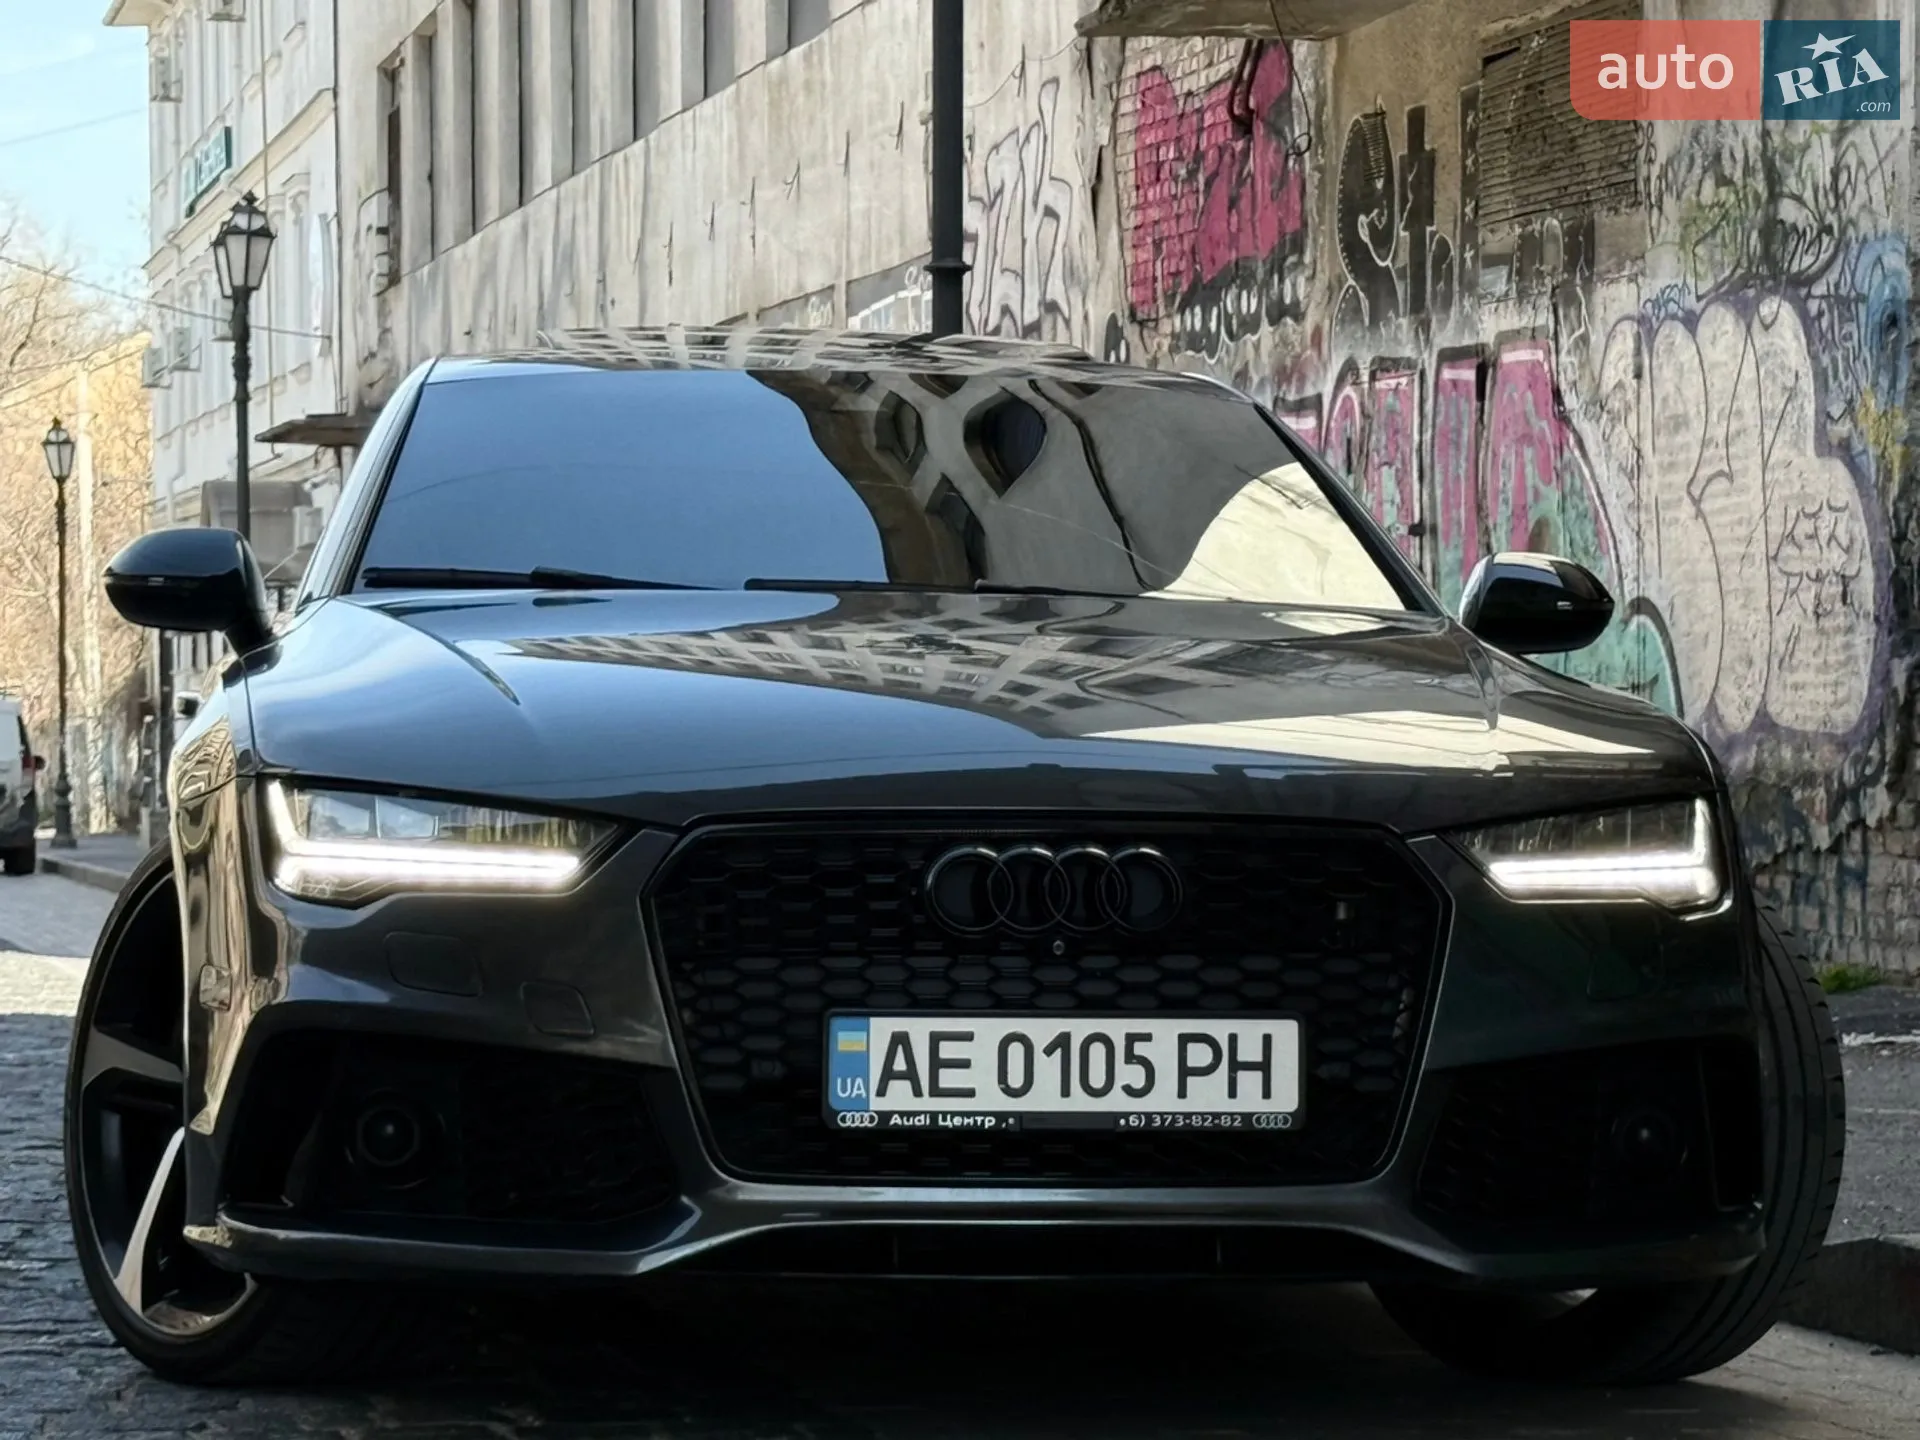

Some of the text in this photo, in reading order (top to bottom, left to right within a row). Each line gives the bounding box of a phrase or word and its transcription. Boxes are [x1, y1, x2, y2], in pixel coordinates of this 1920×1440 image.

[875, 1030, 1272, 1100] AE 0105 PH
[837, 1077, 867, 1098] UA
[889, 1113, 930, 1126] Audi
[938, 1113, 996, 1129] Центр
[1124, 1113, 1243, 1128] 6) 373-82-82
